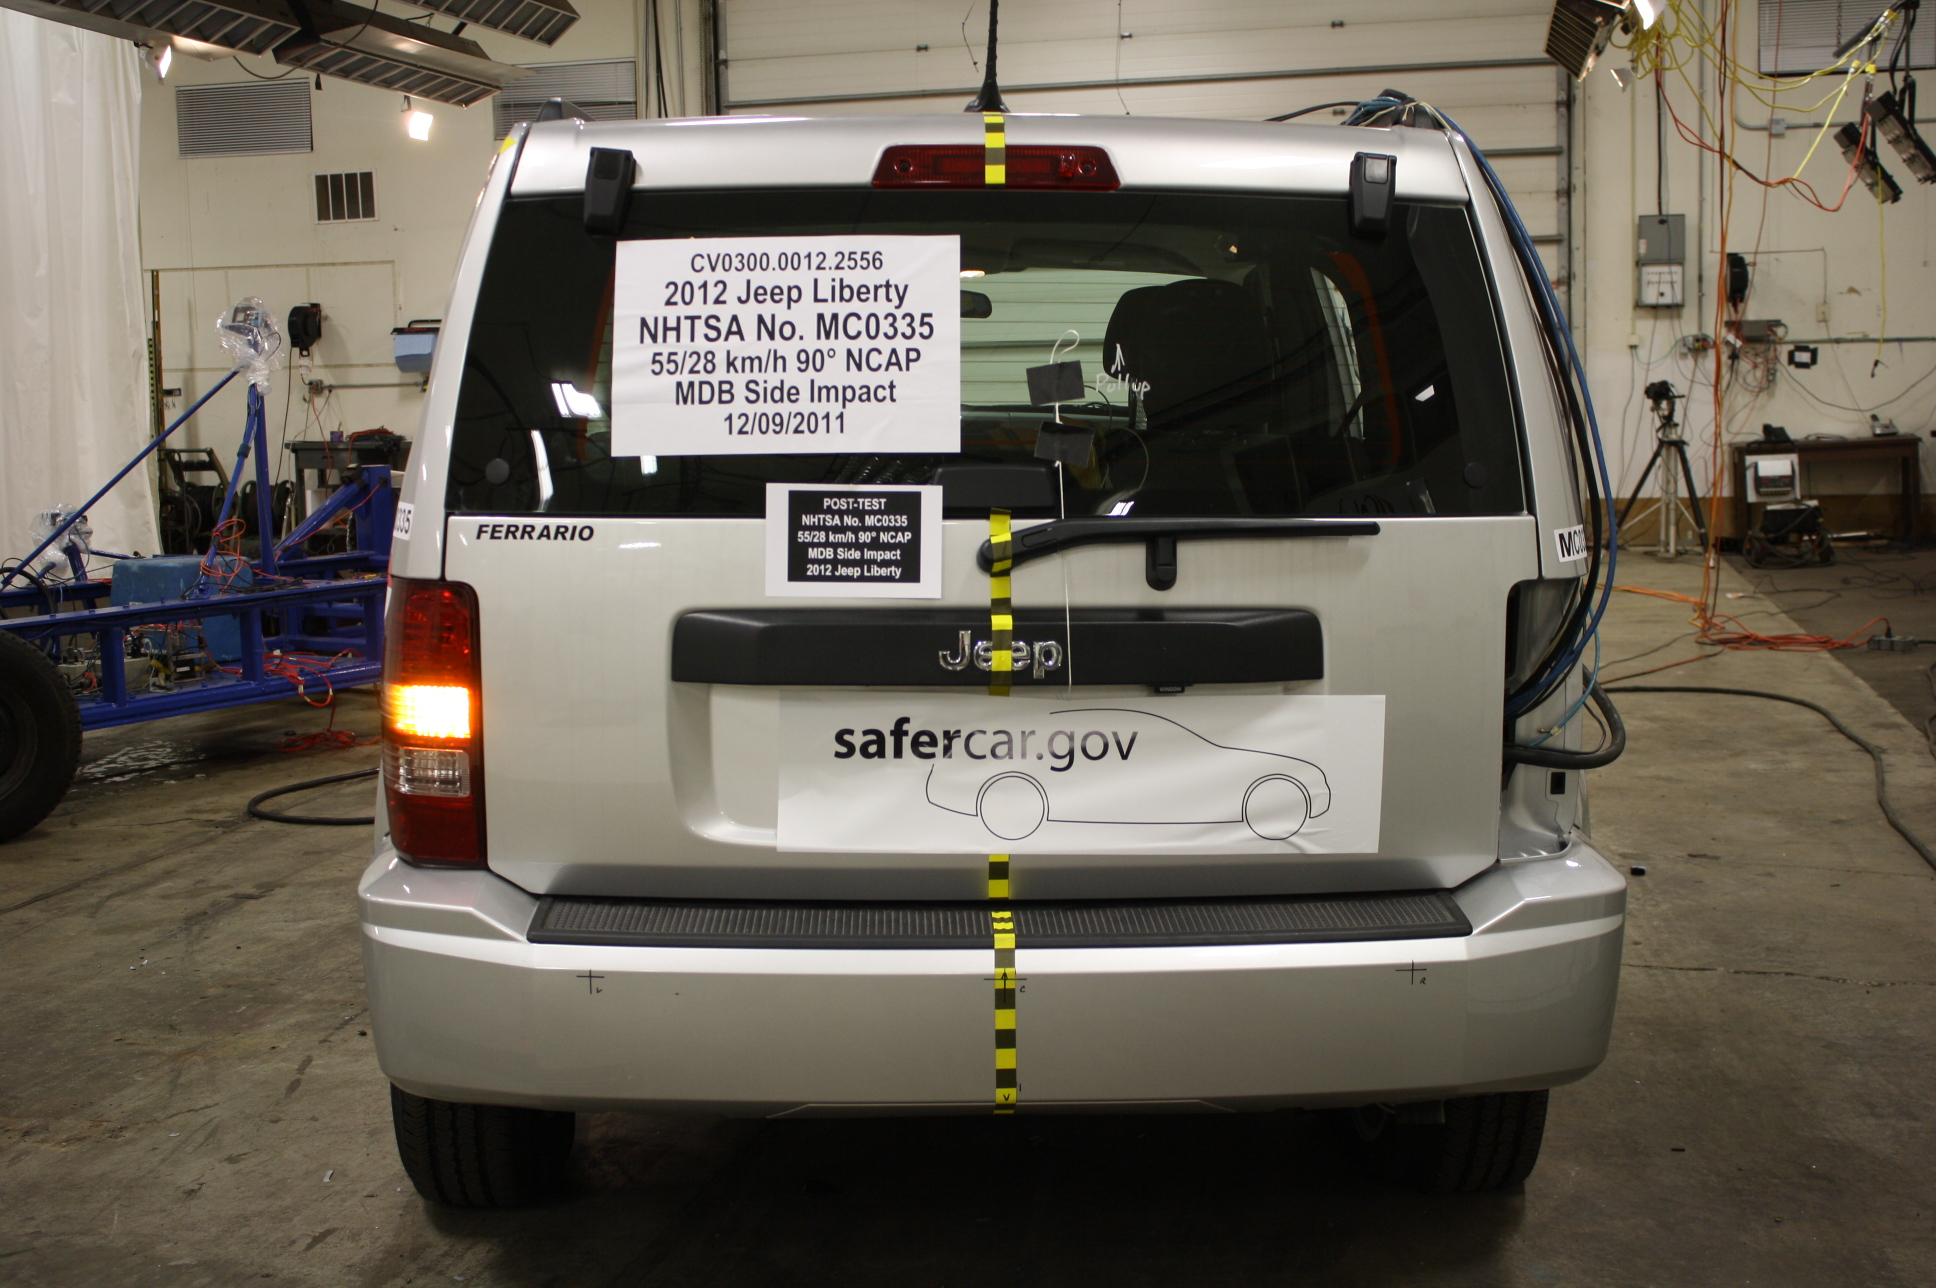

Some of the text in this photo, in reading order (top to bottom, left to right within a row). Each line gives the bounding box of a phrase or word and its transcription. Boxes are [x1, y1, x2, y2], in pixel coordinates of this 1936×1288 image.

[690, 250, 884, 273] CV0300.0012.2556
[664, 278, 909, 311] 2012 Jeep Liberty
[639, 312, 934, 345] NHTSA No. MC0335
[650, 347, 922, 376] 55/28 km/h 90° NCAP
[675, 378, 897, 410] MDB Side Impact
[724, 411, 845, 436] 12/09/2011
[823, 498, 887, 510] POST-TEST
[801, 514, 908, 527] NHTSA No. MC0335
[476, 524, 595, 542] FERRARIO
[797, 530, 826, 543] 55/28
[828, 530, 856, 543] km/h
[879, 531, 912, 544] NCAP
[808, 547, 901, 562] MDB Side Impact
[806, 563, 902, 579] 2012 Jeep Liberty
[938, 630, 1063, 680] Jeep
[833, 716, 1139, 773] safercar.gov
